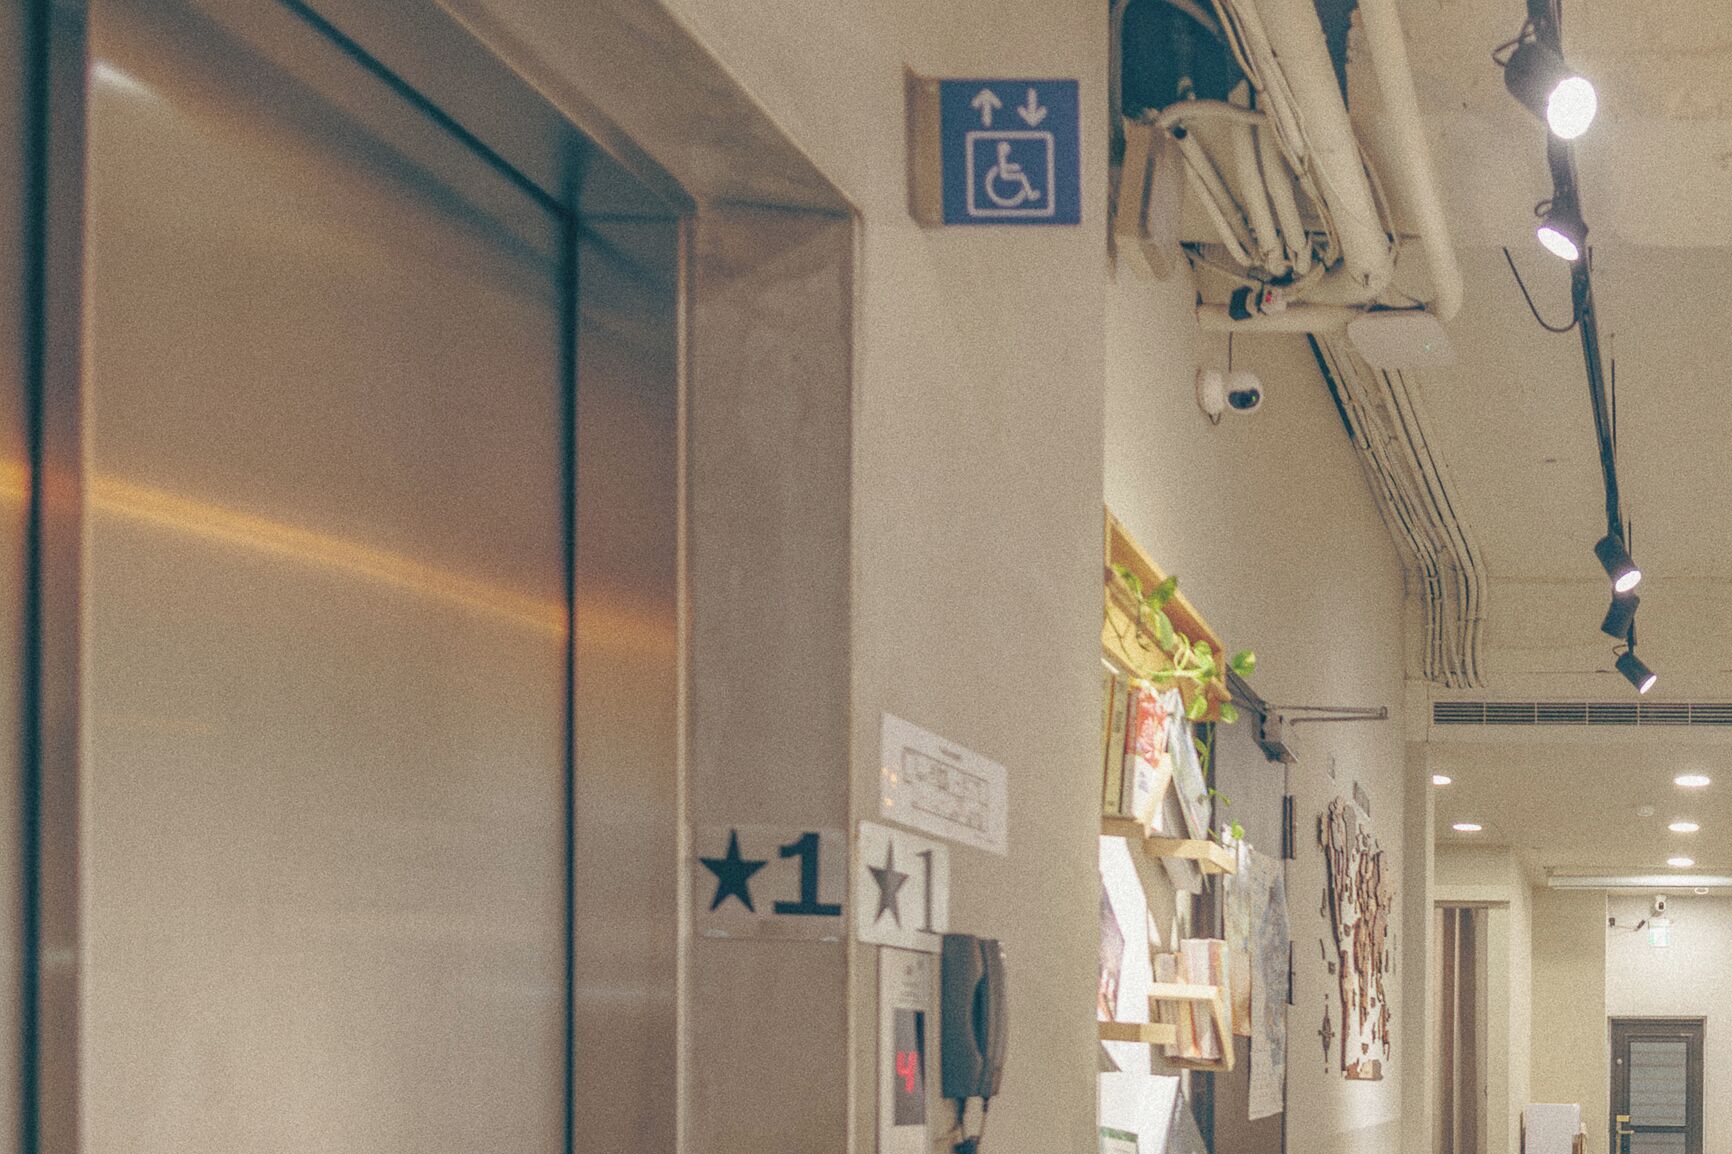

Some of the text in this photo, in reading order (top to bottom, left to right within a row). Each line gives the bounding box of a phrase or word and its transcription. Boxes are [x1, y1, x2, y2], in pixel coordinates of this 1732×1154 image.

[773, 832, 842, 916] 1
[914, 849, 939, 935] 1
[896, 1051, 918, 1094] 4
